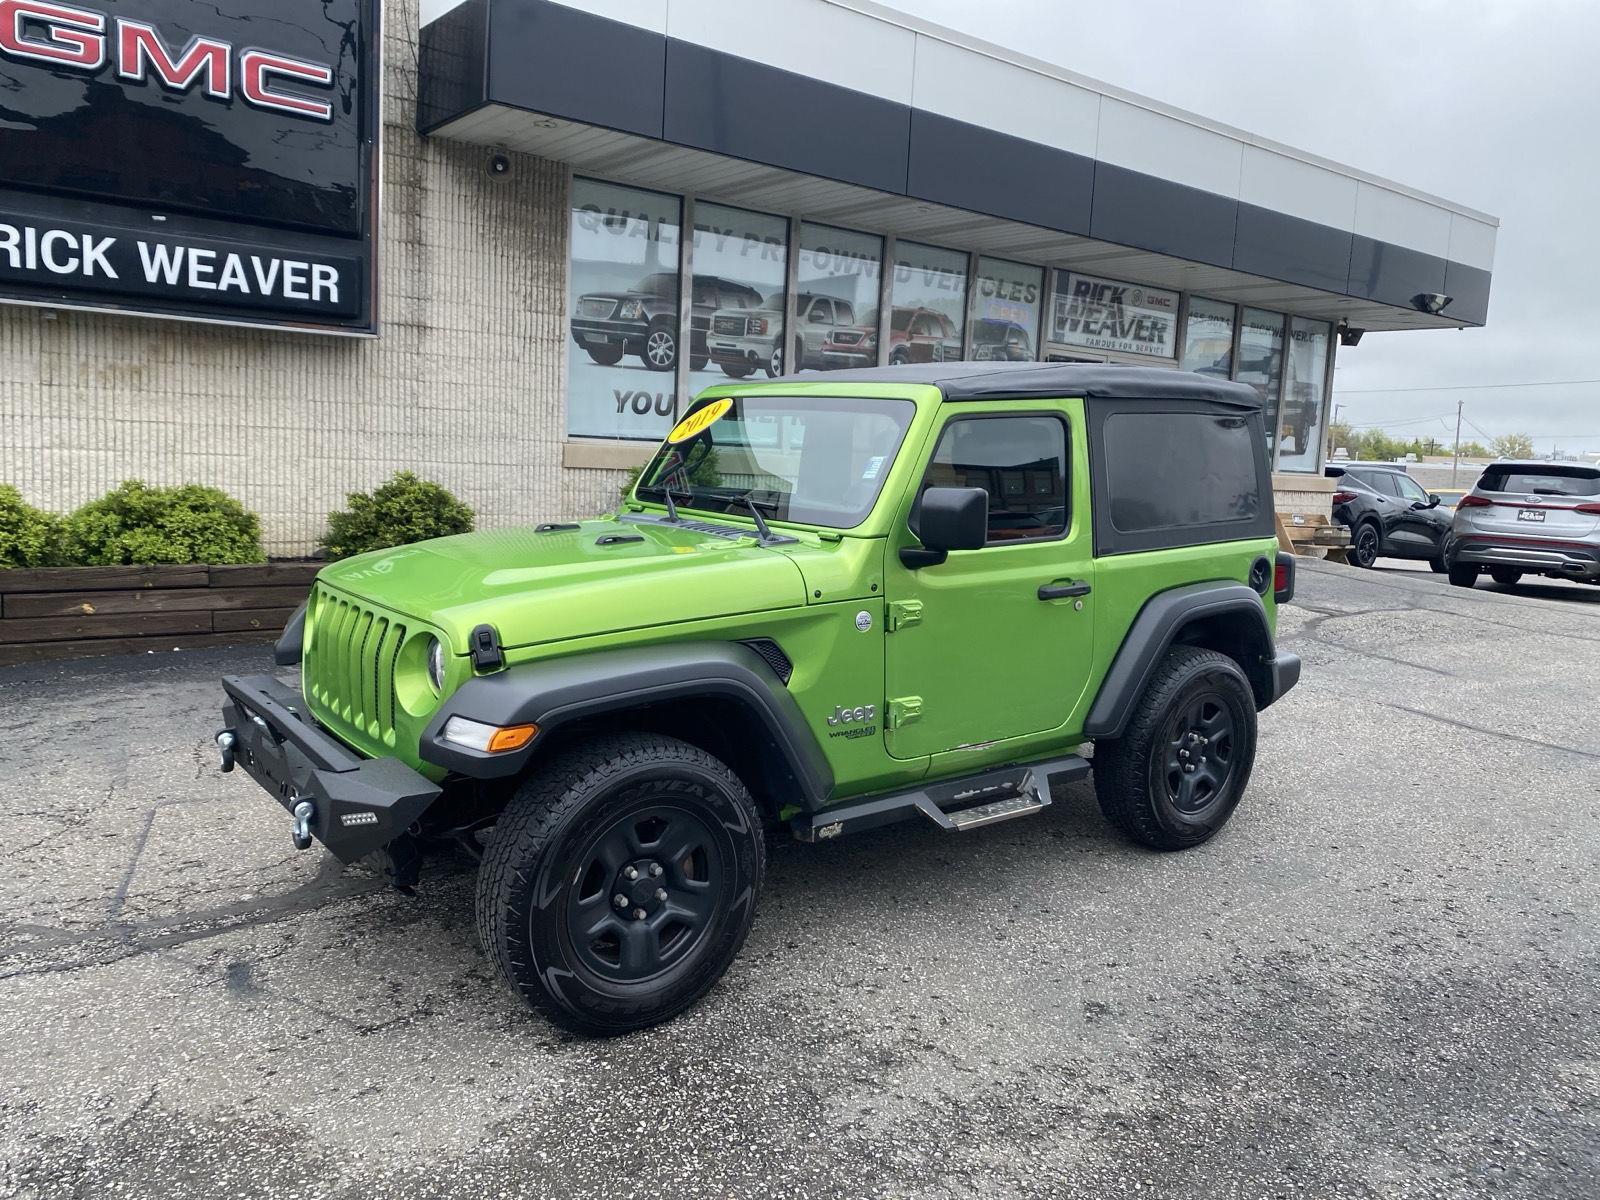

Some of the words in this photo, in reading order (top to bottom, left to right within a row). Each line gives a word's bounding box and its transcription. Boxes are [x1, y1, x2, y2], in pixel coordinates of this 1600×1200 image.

[0, 0, 333, 121] GMC
[0, 223, 119, 279] RICK
[137, 241, 339, 303] WEAVER
[578, 204, 733, 252] QUALTY
[743, 232, 911, 283] PR-OWND
[922, 263, 1037, 303] VEHCLES
[1073, 281, 1129, 308] RICK
[1147, 296, 1171, 307] GMC
[1056, 302, 1169, 344] WEAVER
[1085, 338, 1115, 348] FAMOUS
[1119, 342, 1132, 350] FOR
[1136, 345, 1164, 354] SERVICE
[613, 389, 693, 416] YOU
[678, 402, 722, 439] 2019
[827, 704, 877, 727] Jeep
[828, 726, 876, 739] WRANGLER
